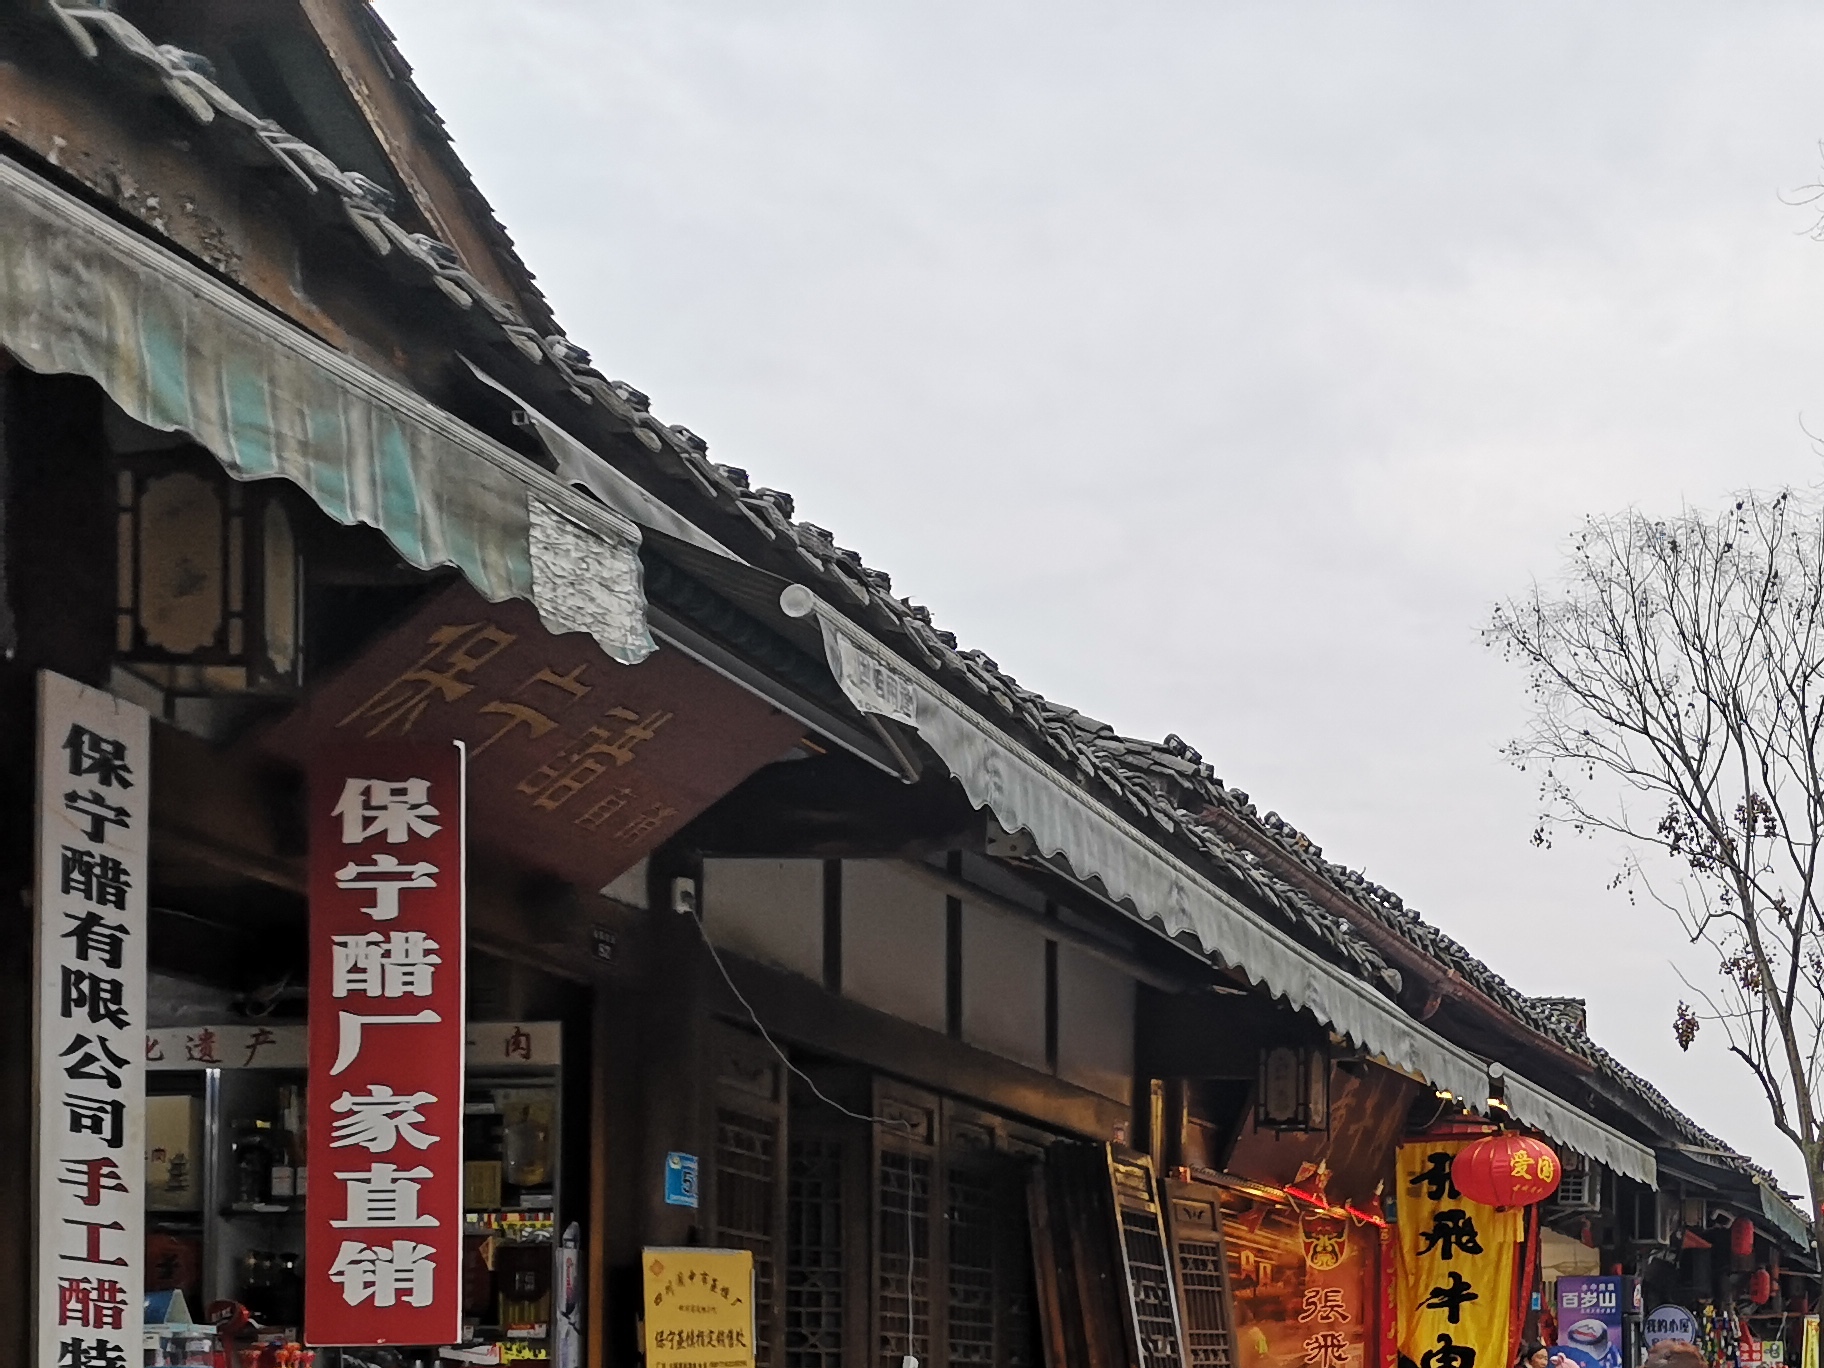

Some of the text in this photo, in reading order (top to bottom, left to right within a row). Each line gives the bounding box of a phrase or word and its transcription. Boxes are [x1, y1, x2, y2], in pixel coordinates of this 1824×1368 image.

[329, 777, 443, 1306] 保宁醋厂家直销
[1510, 1149, 1555, 1183] 爱国
[1562, 1291, 1616, 1309] 百岁山
[1646, 1318, 1691, 1334] 我的小屋
